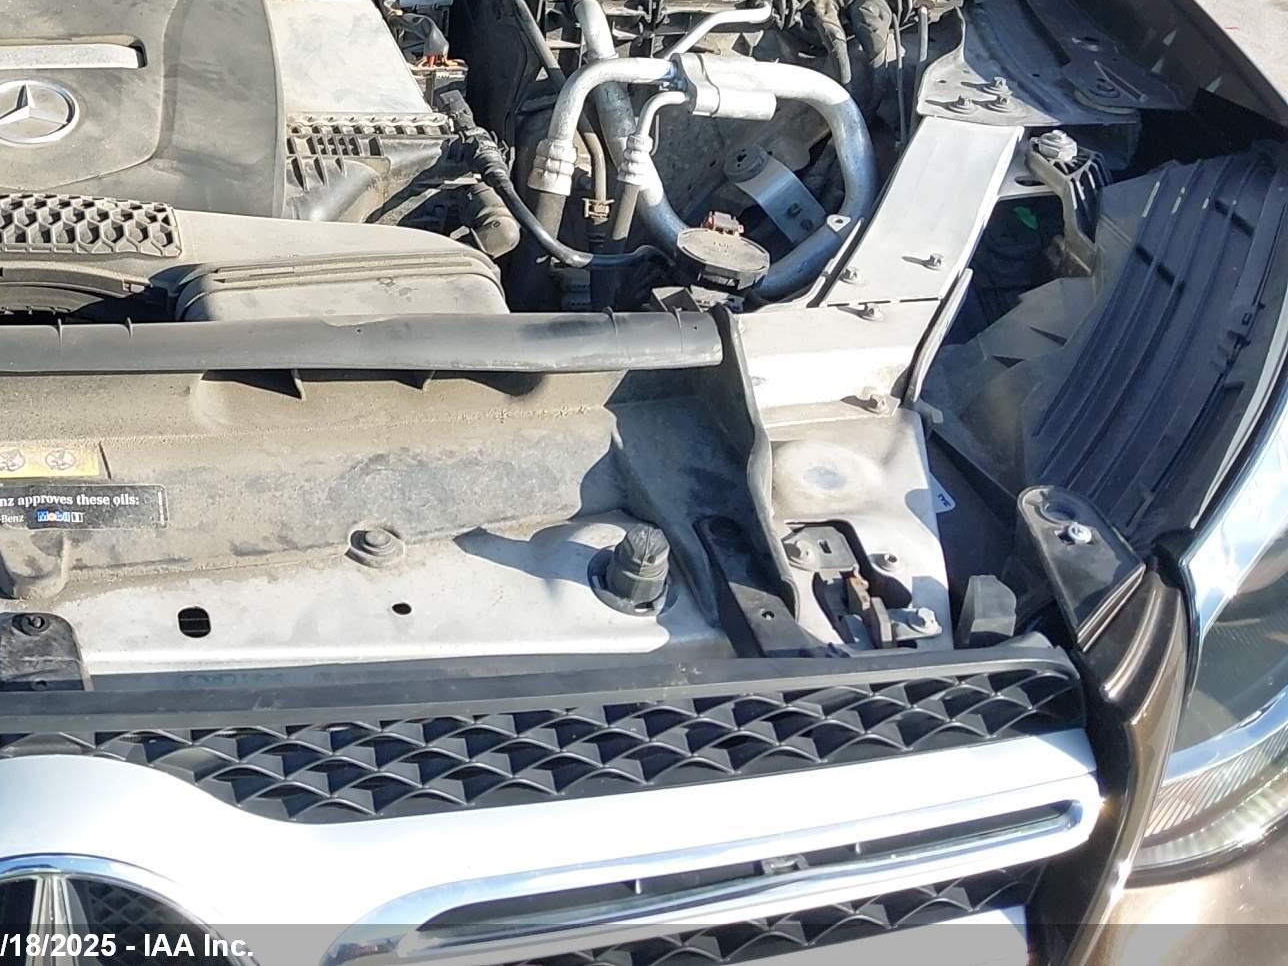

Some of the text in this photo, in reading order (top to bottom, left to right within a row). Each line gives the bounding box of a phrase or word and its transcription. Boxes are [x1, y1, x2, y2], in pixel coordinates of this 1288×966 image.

[17, 494, 73, 507] approves
[76, 493, 110, 506] these
[112, 493, 140, 507] oils:
[37, 511, 71, 522] Mobil
